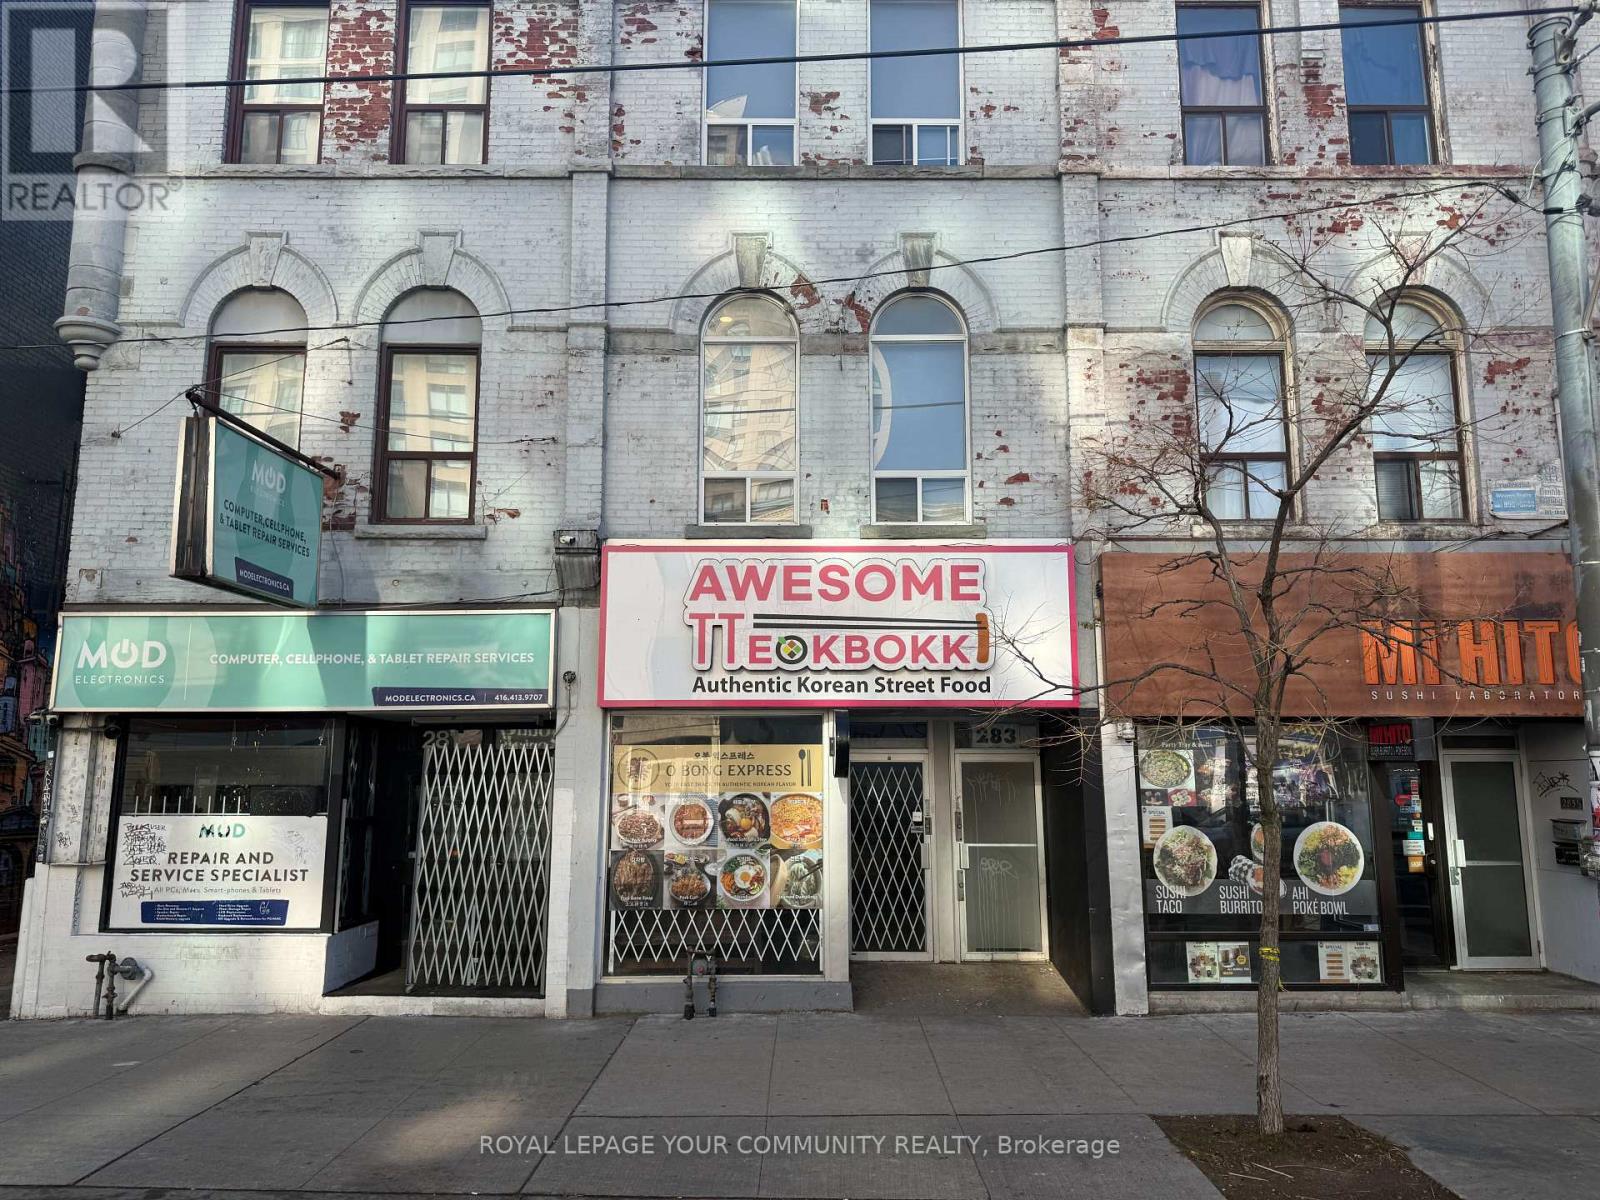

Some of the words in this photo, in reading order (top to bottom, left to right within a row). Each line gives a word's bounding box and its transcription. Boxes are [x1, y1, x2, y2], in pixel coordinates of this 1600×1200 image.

[219, 513, 225, 524] &
[226, 516, 251, 534] TABLET
[252, 527, 277, 545] REPAIR
[278, 538, 310, 558] SERVICES
[688, 564, 981, 602] AWESOME
[77, 639, 167, 669] MOD
[209, 654, 283, 666] COMPUTER,
[285, 653, 365, 665] CELLPHONE,
[367, 654, 377, 664] &
[380, 653, 424, 664] TABLET
[427, 653, 471, 664] REPAIR
[474, 652, 535, 663] SERVICES
[75, 675, 165, 685] ELECTRONICS
[692, 676, 792, 693] Authentic
[797, 676, 869, 693] Korean
[874, 676, 935, 693] Street
[940, 676, 991, 693] Food
[385, 693, 476, 702] MODELECTRONICS.CA
[494, 693, 543, 702] 416.413.9707
[1371, 691, 1437, 700] SUSHI
[1455, 691, 1581, 700] LABORATOR
[975, 728, 1016, 744] 283
[666, 764, 676, 776] O
[682, 764, 722, 776] BONG
[728, 764, 791, 776] EXPRESS
[167, 851, 230, 865] REPAIR
[235, 852, 274, 865] AND
[130, 869, 205, 882] SERVICE
[210, 869, 309, 882] SPECIALIST
[203, 886, 251, 895] Smart-phones
[1155, 886, 1186, 899] SUSHI
[1219, 886, 1249, 899] SUSHI
[1293, 886, 1308, 899] AHI
[1156, 901, 1182, 913] TACO
[1220, 901, 1263, 914] BURRITO
[1293, 898, 1318, 915] POKÉ
[1320, 901, 1349, 915] BOWL
